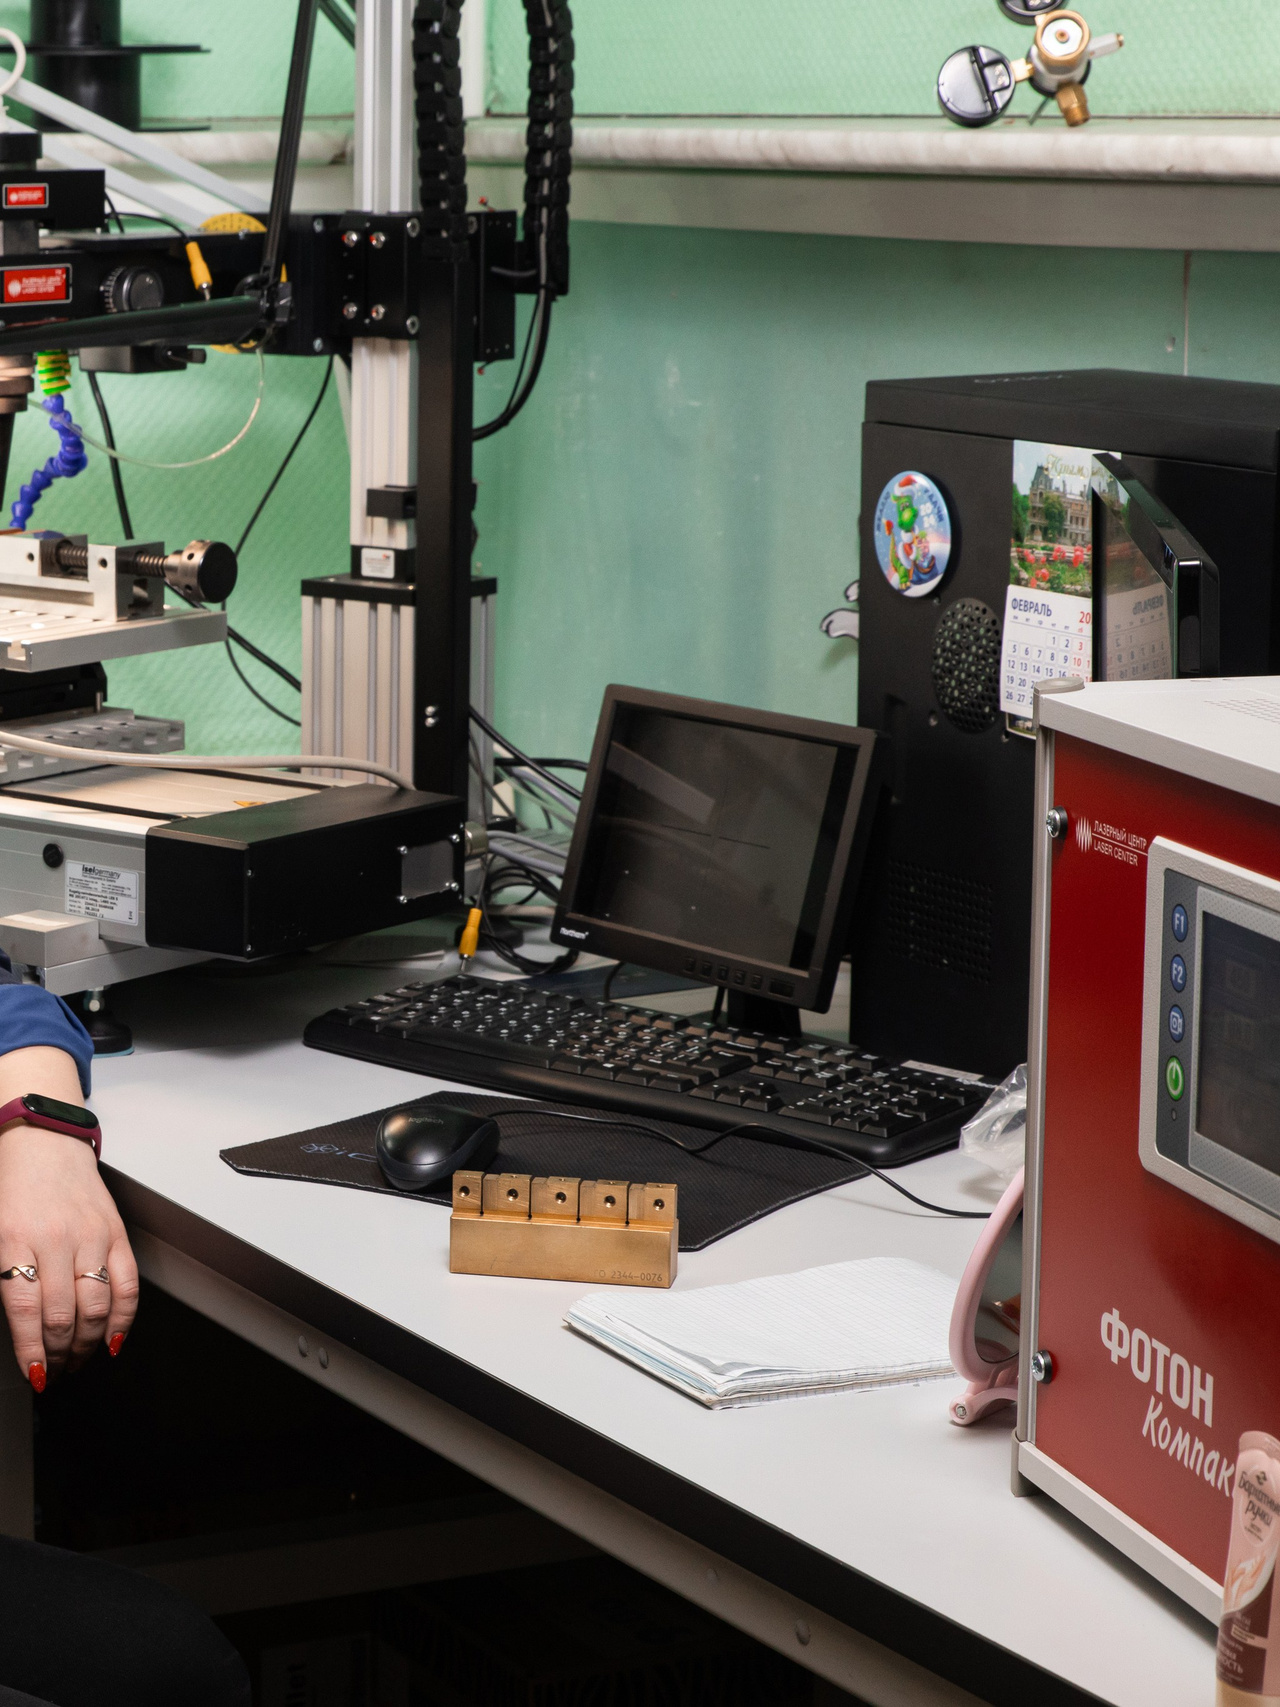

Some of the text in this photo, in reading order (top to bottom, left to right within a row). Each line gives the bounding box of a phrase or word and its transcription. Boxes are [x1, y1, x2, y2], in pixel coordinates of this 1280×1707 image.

[1011, 598, 1052, 617] ФЕВРАЛЬ
[1012, 644, 1017, 653] 5
[1024, 647, 1029, 656] 6
[1037, 650, 1042, 658] 7
[1050, 652, 1055, 661] 8
[1063, 655, 1068, 664] 9
[1073, 657, 1082, 667] 10
[1065, 639, 1070, 648] 2
[1078, 642, 1083, 651] 3
[1007, 659, 1015, 669] 12
[1020, 662, 1028, 672] 13
[1032, 665, 1040, 674] 14
[1045, 667, 1054, 677] 15
[1006, 675, 1014, 684] 19
[1018, 677, 1026, 687] 20
[1006, 690, 1013, 700] 26
[1017, 693, 1025, 702] 27
[1094, 820, 1147, 850] ЛАЗЕРНЫЙ ЦЕНТР
[1094, 839, 1138, 867] LASER CENTER
[1174, 913, 1185, 933] F1
[1172, 963, 1183, 984] F2
[611, 1271, 663, 1282] 2344-0076
[1100, 1307, 1214, 1428] ФОТОН
[1141, 1395, 1235, 1497] Компак
[1238, 1471, 1280, 1516] Бархатны
[1245, 1500, 1273, 1527] ручки
